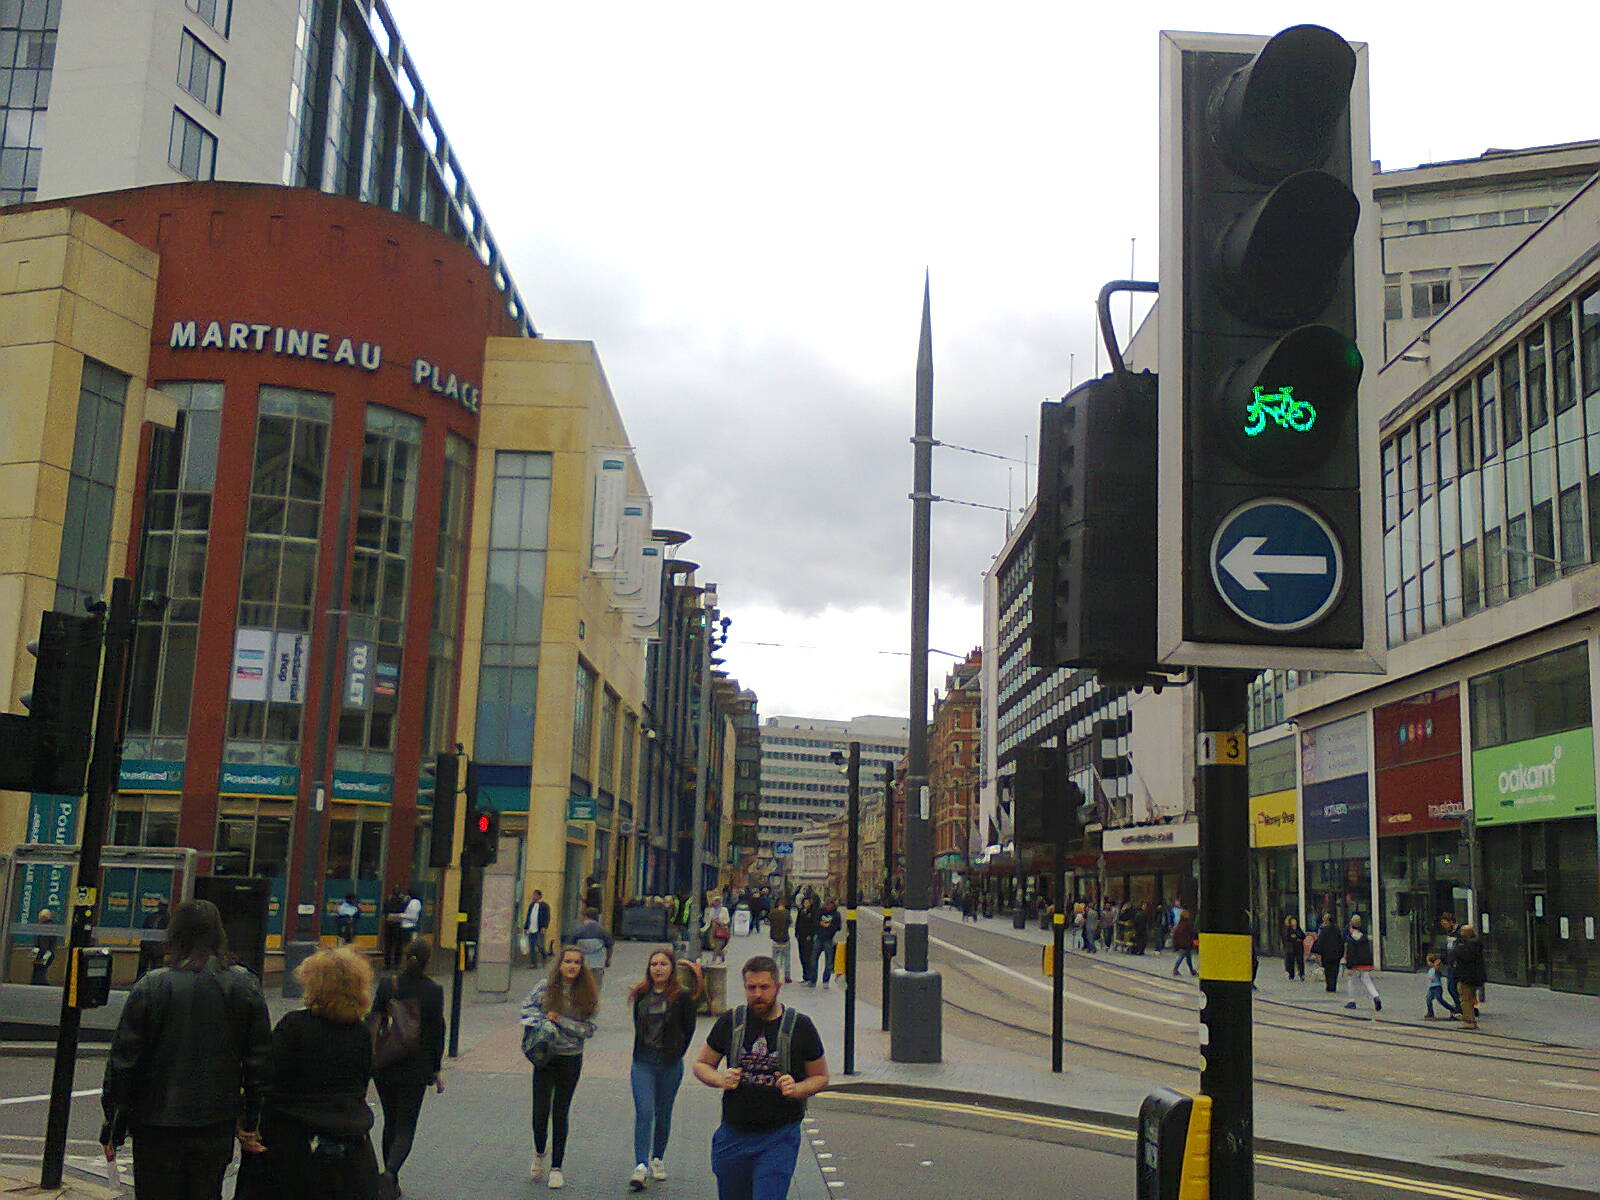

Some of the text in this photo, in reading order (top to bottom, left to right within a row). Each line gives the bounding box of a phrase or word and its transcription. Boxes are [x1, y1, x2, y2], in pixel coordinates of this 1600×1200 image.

[170, 320, 479, 413] MARTINEAU PLACE
[350, 644, 368, 705] TO LET
[1226, 737, 1240, 759] 3
